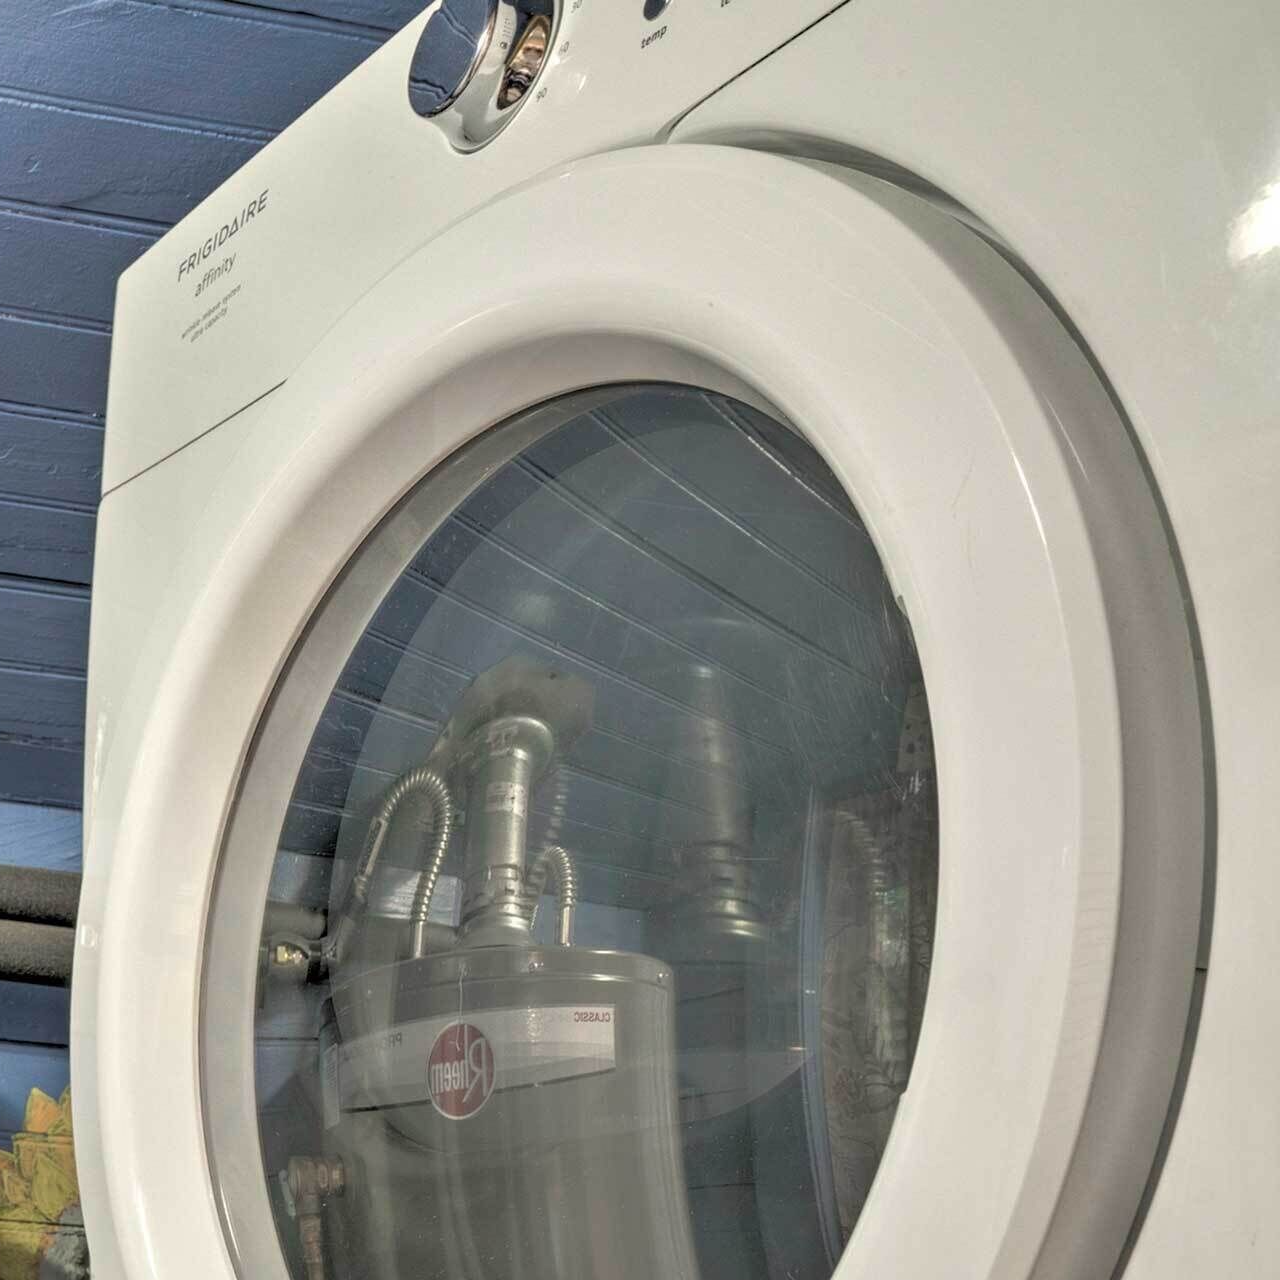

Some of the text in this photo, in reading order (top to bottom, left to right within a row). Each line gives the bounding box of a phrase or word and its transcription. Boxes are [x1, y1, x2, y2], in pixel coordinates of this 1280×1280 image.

[640, 25, 668, 49] temp
[177, 188, 270, 283] FRIGIDAIRE
[195, 253, 237, 297] affinity
